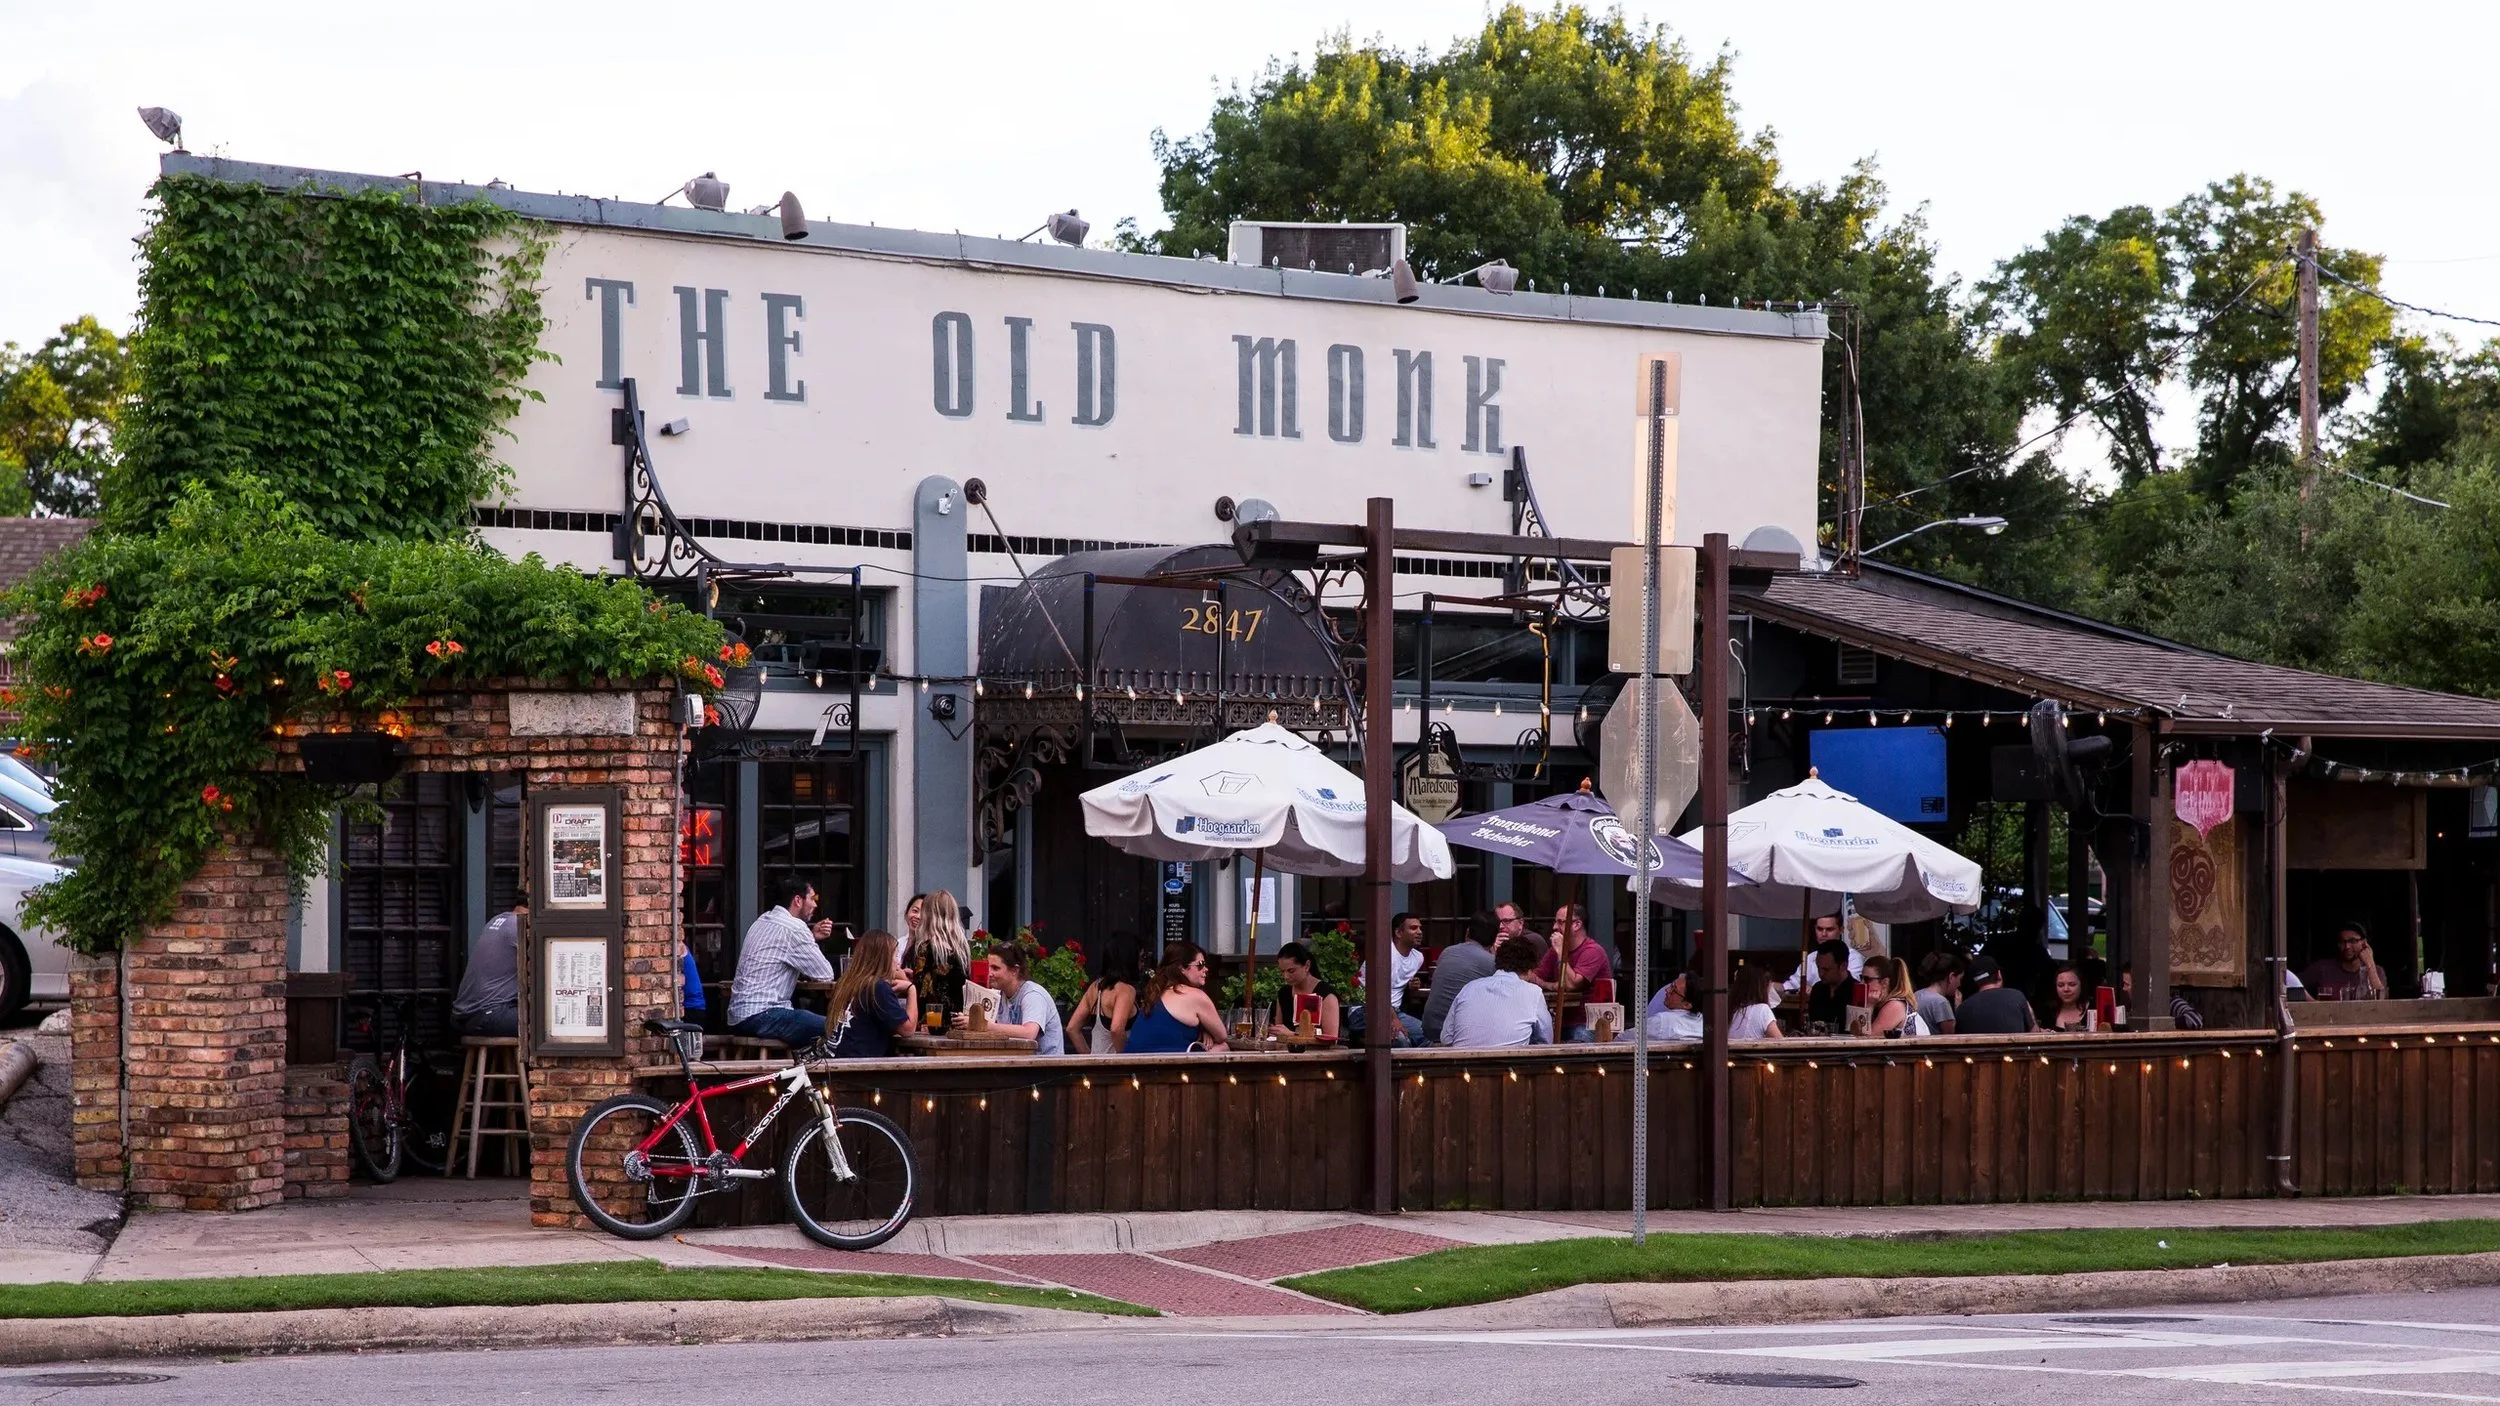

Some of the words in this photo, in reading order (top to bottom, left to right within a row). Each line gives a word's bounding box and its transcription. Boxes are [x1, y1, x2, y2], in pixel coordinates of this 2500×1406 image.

[585, 277, 807, 404] THE
[932, 311, 1117, 428] OLD
[1231, 334, 1506, 455] MONK
[1181, 604, 1263, 642] 2847
[1409, 775, 1458, 795] Maredsous
[1197, 816, 1262, 836] Hoegaarden
[745, 1092, 793, 1148] KONA
